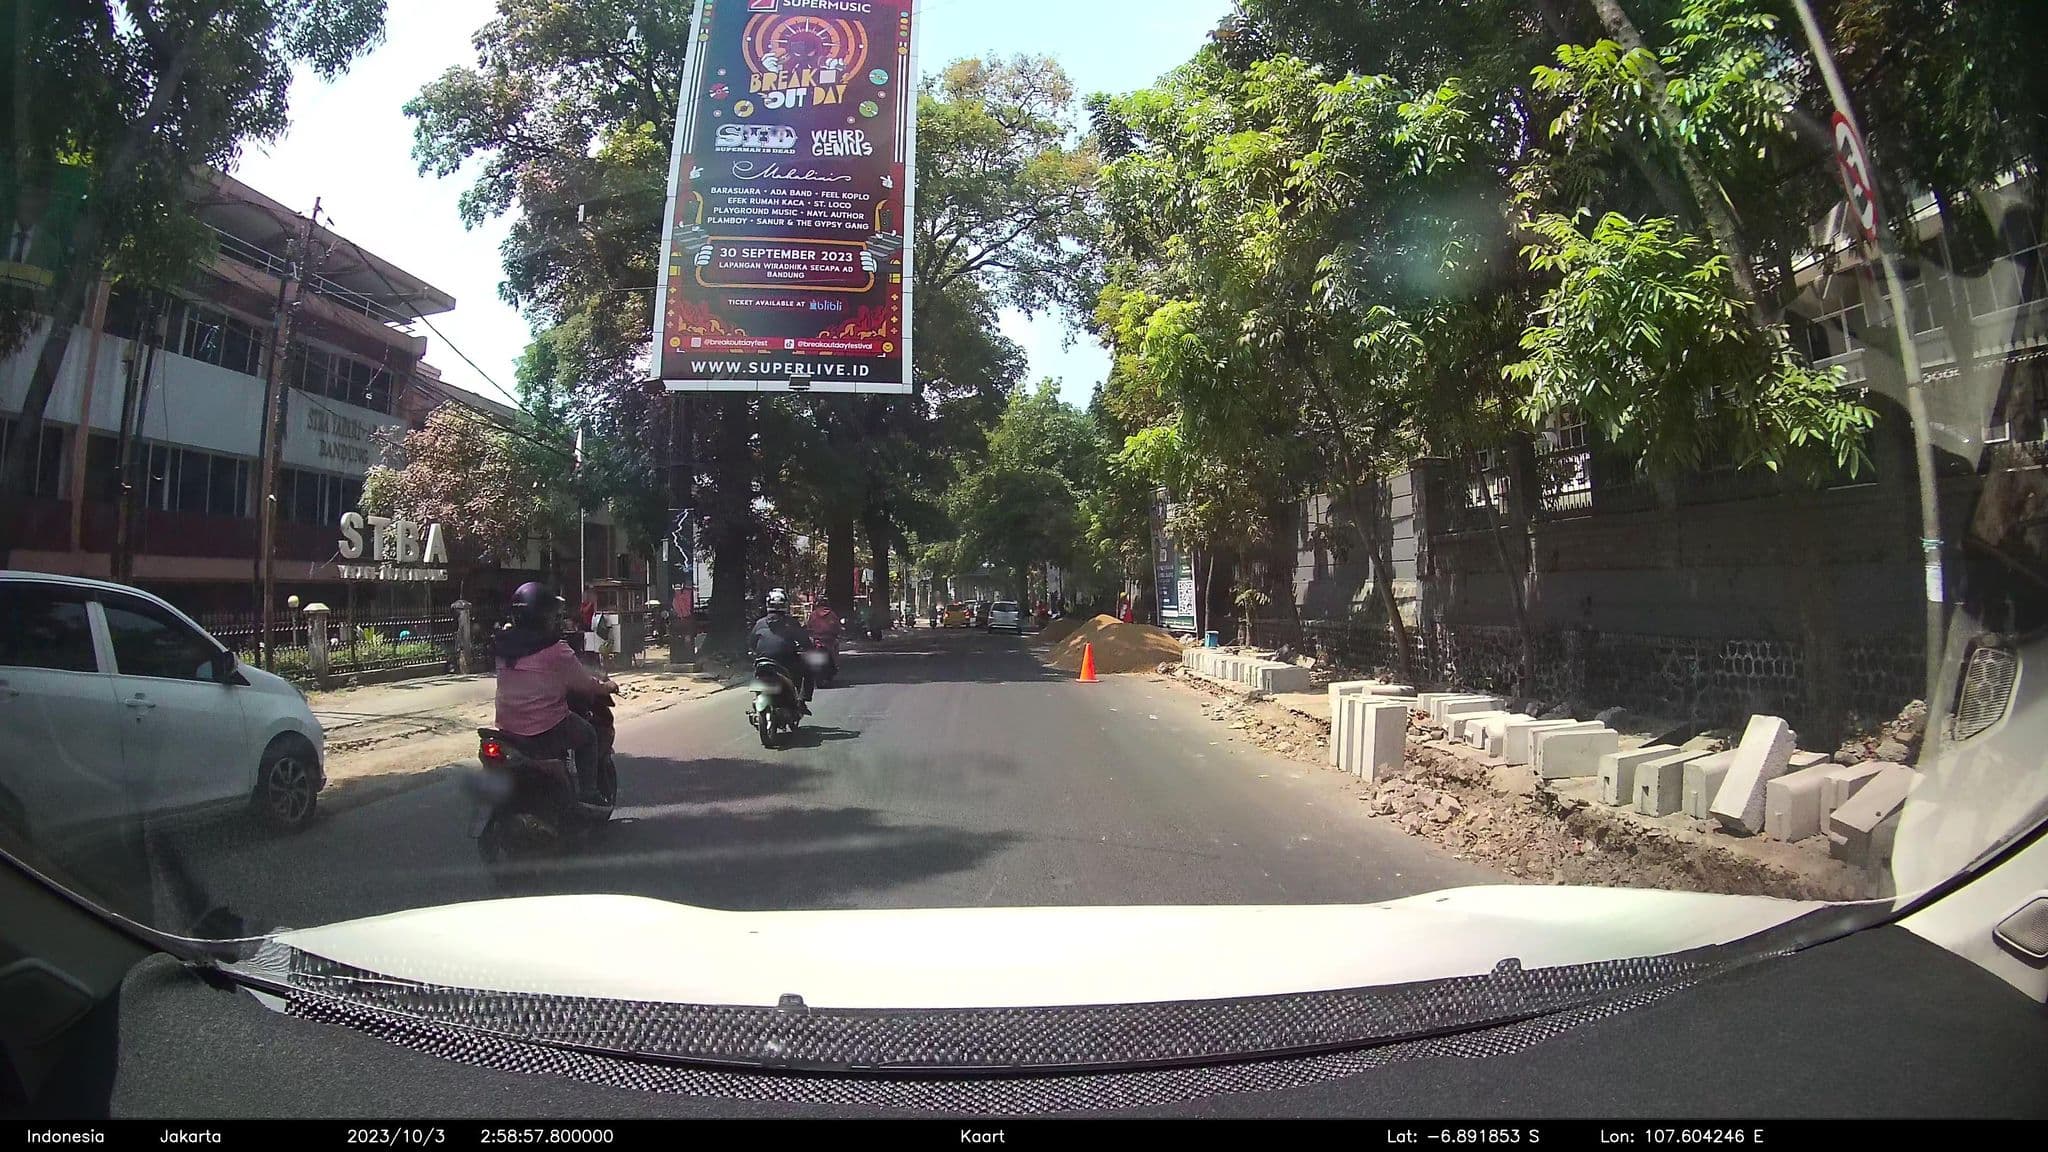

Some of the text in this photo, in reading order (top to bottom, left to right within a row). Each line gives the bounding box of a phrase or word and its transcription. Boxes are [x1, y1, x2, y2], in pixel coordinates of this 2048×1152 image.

[783, 0, 871, 13] SUPERMUSIC
[749, 68, 817, 93] BREAK
[763, 84, 849, 110] OUT DAY
[811, 129, 865, 144] WEIRD
[812, 141, 873, 157] GENIUS
[710, 187, 761, 195] BARASUARA
[821, 191, 839, 199] FEEL
[842, 192, 870, 201] KOPLO
[750, 198, 779, 206] RUMAH
[782, 199, 804, 207] KACA
[828, 201, 851, 209] LOCO
[713, 207, 865, 220] PLAYGROUND MUSIC NAYL AUTHOR
[756, 218, 785, 226] SANUR
[814, 221, 842, 229] GYPSY
[845, 222, 869, 230] GANG
[720, 248, 853, 262] 30 SEPTEMBER 2023
[763, 263, 808, 271] WIRADHIKA
[767, 271, 805, 279] BANDUNG
[818, 300, 842, 312] blibli
[704, 339, 873, 350] @breakoutdayfest @breakoutdayfestival
[690, 361, 870, 377] WWW.SUPERLIVE.ID
[338, 511, 449, 564] STBA
